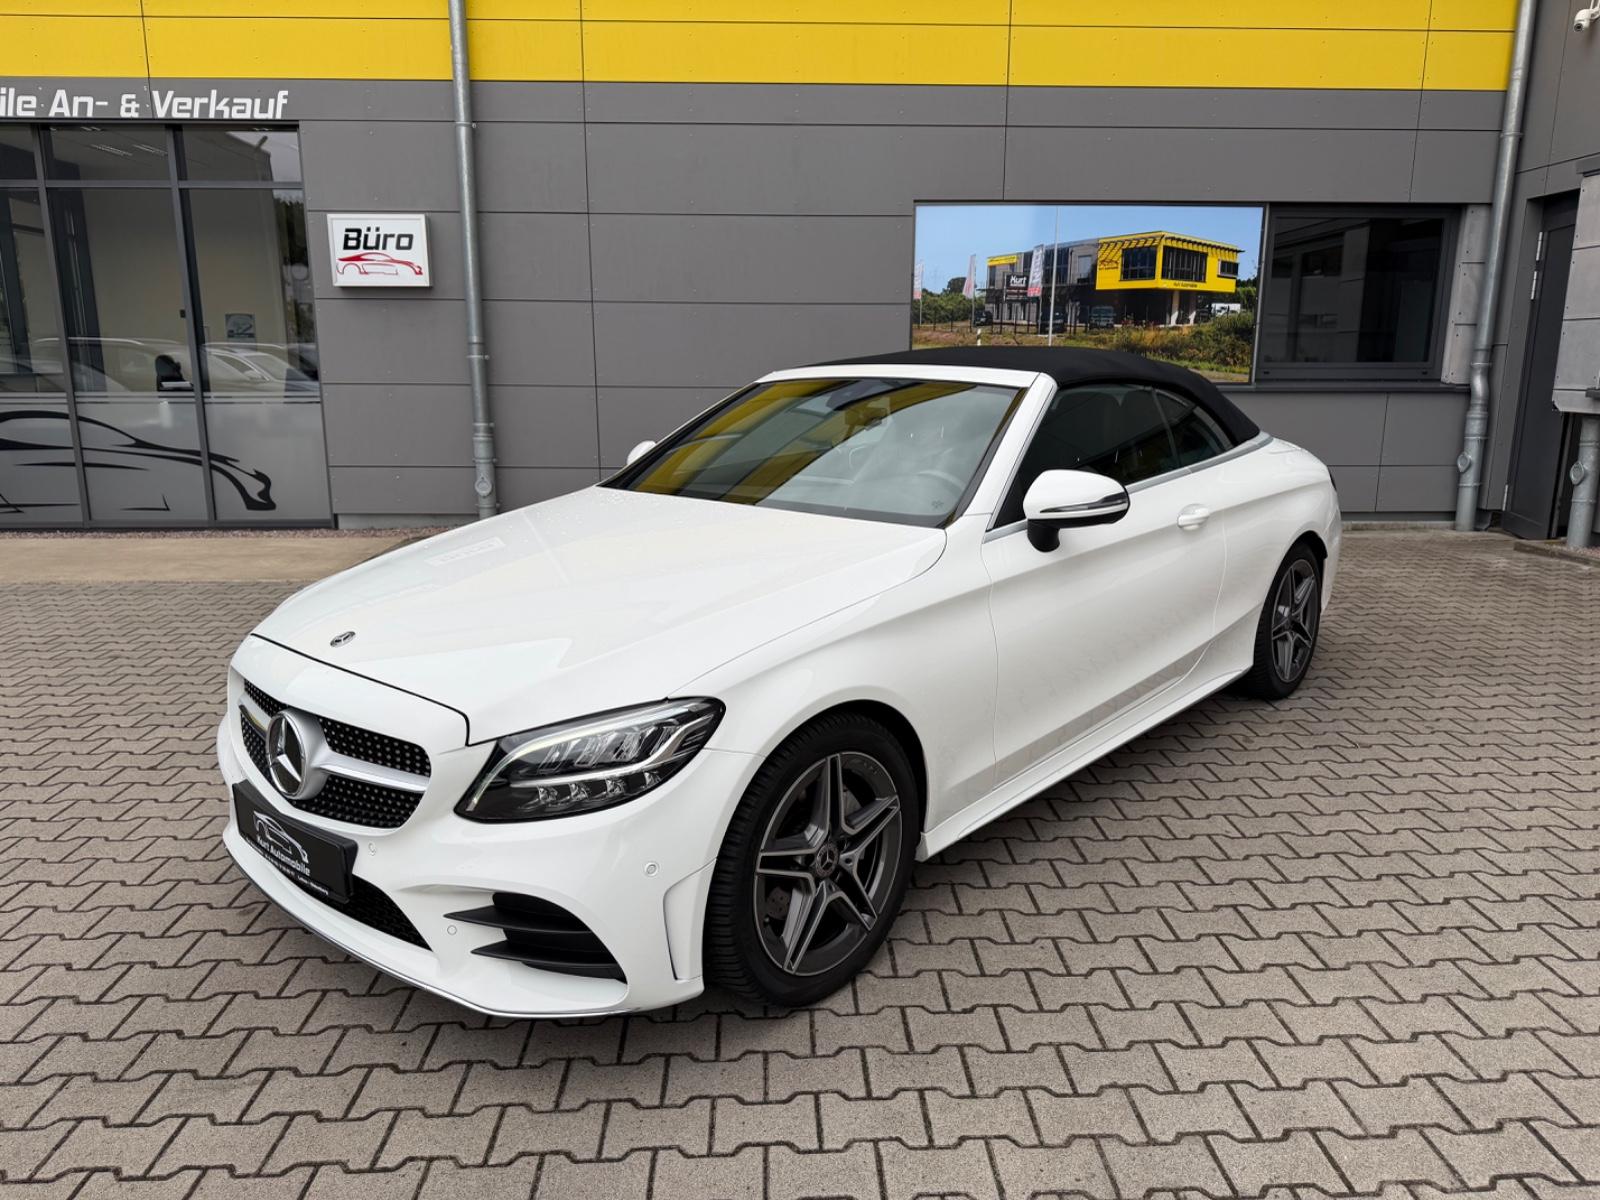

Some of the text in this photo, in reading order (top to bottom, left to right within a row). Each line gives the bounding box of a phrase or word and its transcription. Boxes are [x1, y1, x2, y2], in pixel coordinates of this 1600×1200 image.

[48, 89, 108, 118] An-
[120, 94, 140, 118] &
[152, 89, 289, 119] Verkauf
[343, 226, 414, 251] Büro
[270, 844, 311, 876] Automobile
